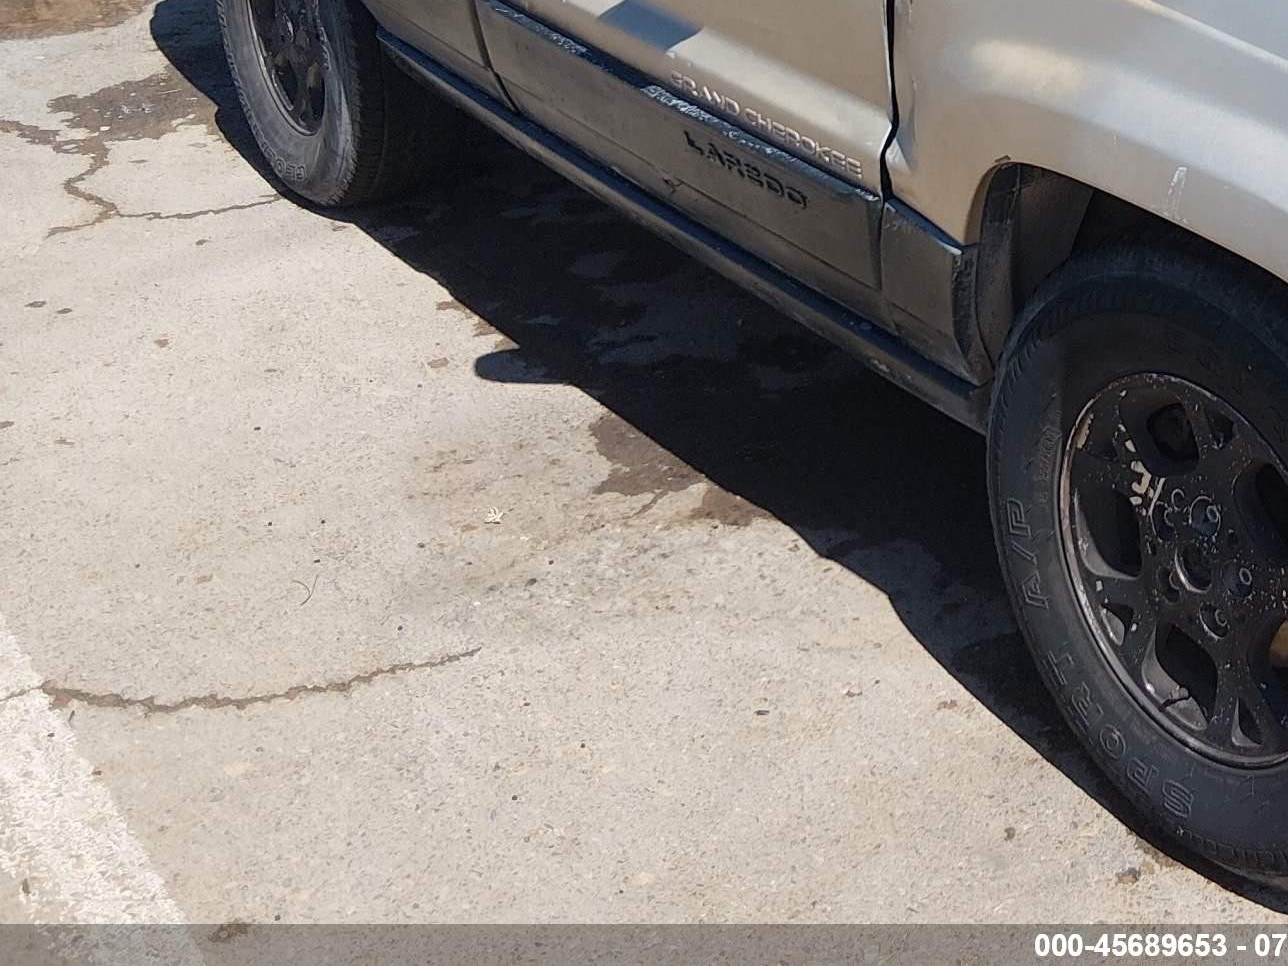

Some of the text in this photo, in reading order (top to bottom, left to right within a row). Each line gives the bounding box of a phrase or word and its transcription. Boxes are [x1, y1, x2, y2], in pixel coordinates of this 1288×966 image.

[669, 70, 864, 180] GRAND CHEROKEE
[683, 129, 810, 211] LAREDO
